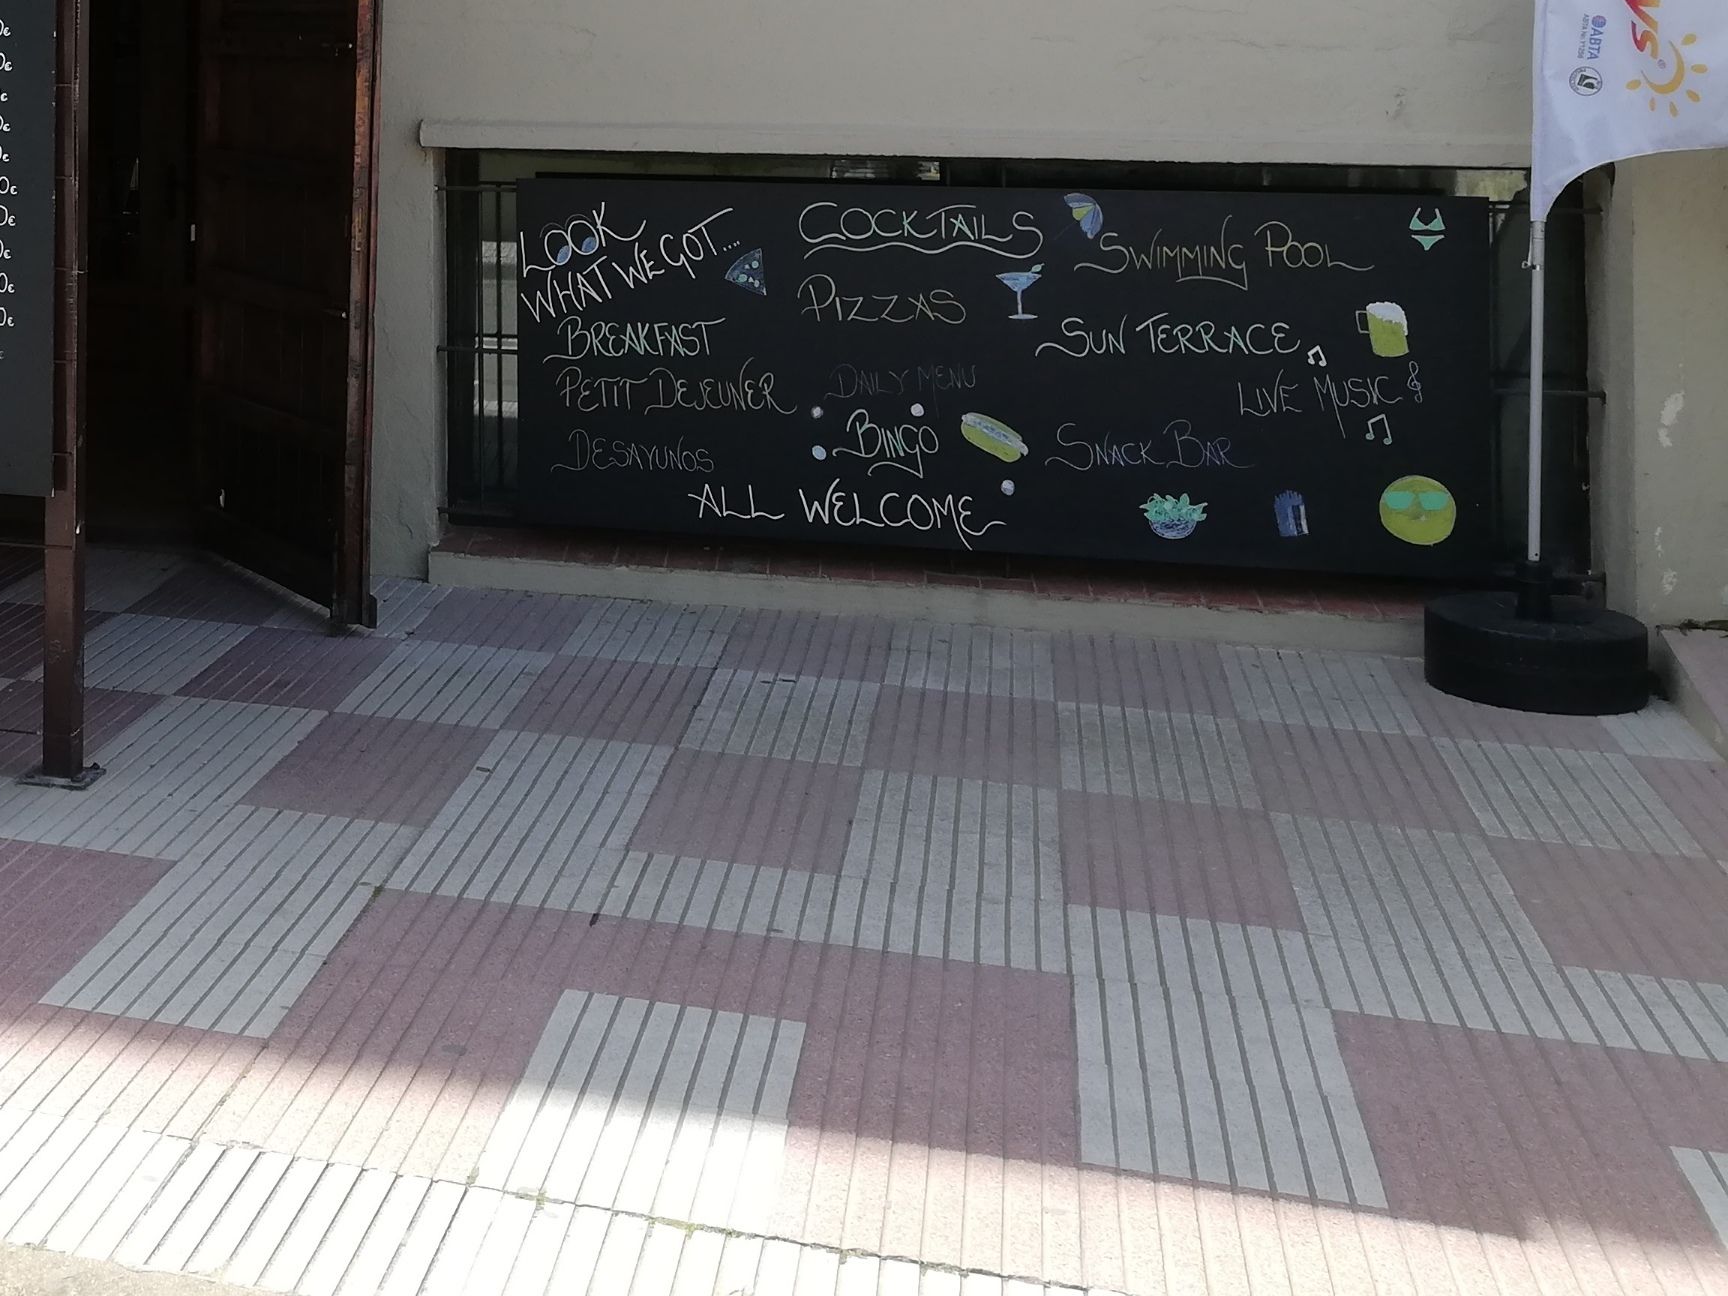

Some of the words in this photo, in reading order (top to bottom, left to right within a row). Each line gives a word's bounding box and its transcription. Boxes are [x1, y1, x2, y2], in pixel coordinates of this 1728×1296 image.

[1587, 27, 1604, 61] ABTA
[519, 201, 646, 279] LOOK
[798, 201, 1044, 259] COCKTAILS
[1073, 215, 1248, 284] SWIMMING
[1254, 221, 1375, 271] POOL
[521, 254, 613, 323] WHAT
[611, 241, 664, 289] WE
[797, 273, 967, 325] PIZZAS
[542, 315, 727, 363] BREAKFAST
[1035, 313, 1128, 357] SUN
[1135, 312, 1301, 355] TERRACE
[554, 365, 649, 412] PETIT
[644, 356, 797, 416] DEJEUNER
[824, 363, 910, 400] DAILY
[917, 364, 977, 402] MENU
[1238, 369, 1303, 418] LIVE
[1313, 374, 1403, 425] MUSIC
[551, 427, 715, 473] DESAYUNOS
[831, 408, 940, 473] BINGO
[1044, 421, 1165, 471] SNACK
[1162, 419, 1255, 470] BAR
[688, 483, 785, 520] ALL
[798, 477, 1007, 542] WELCOME
